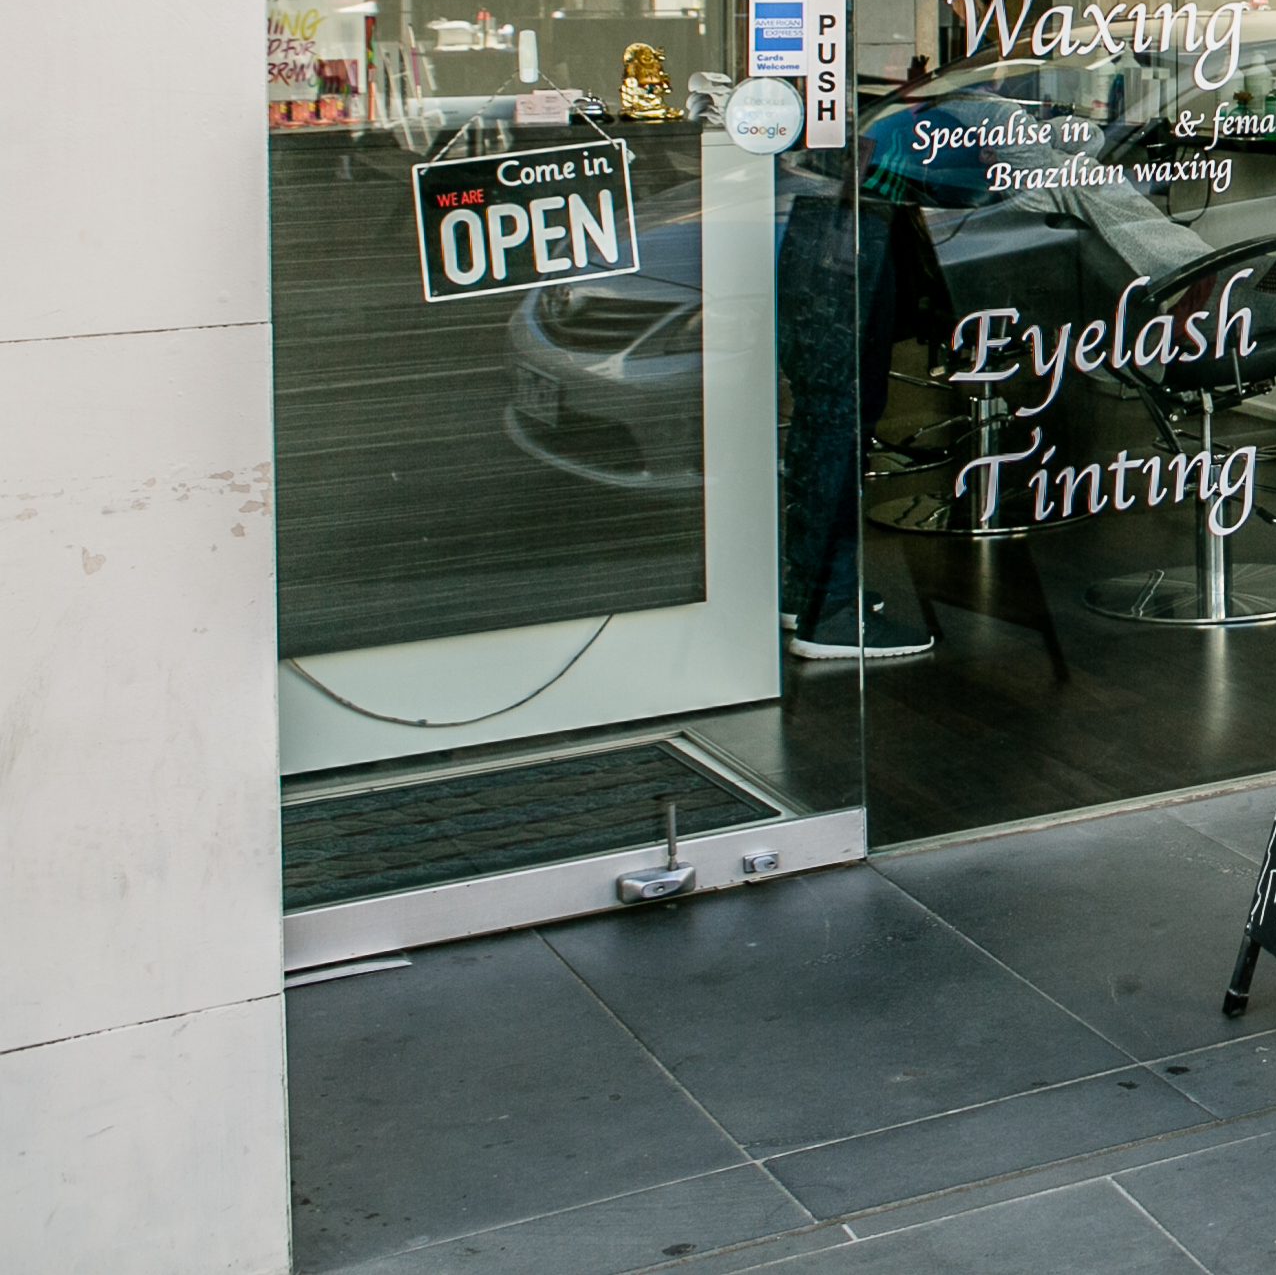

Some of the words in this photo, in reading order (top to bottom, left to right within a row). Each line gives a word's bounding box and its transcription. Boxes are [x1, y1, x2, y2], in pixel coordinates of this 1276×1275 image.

[755, 19, 800, 27] AMERICAN
[765, 28, 804, 36] EXPRESS
[817, 14, 837, 121] PUSH
[737, 121, 787, 138] Google
[912, 107, 1052, 164] Specialise
[1060, 114, 1092, 143] in
[1175, 109, 1205, 137] &
[497, 160, 576, 186] Come
[583, 151, 613, 175] in
[987, 151, 1127, 192] Brazilian
[1133, 154, 1232, 193] waxing
[436, 192, 458, 207] WE
[461, 189, 484, 204] ARE
[440, 188, 619, 284] OPEN
[949, 268, 1258, 419] Eyelash
[954, 426, 1258, 537] Tinting
